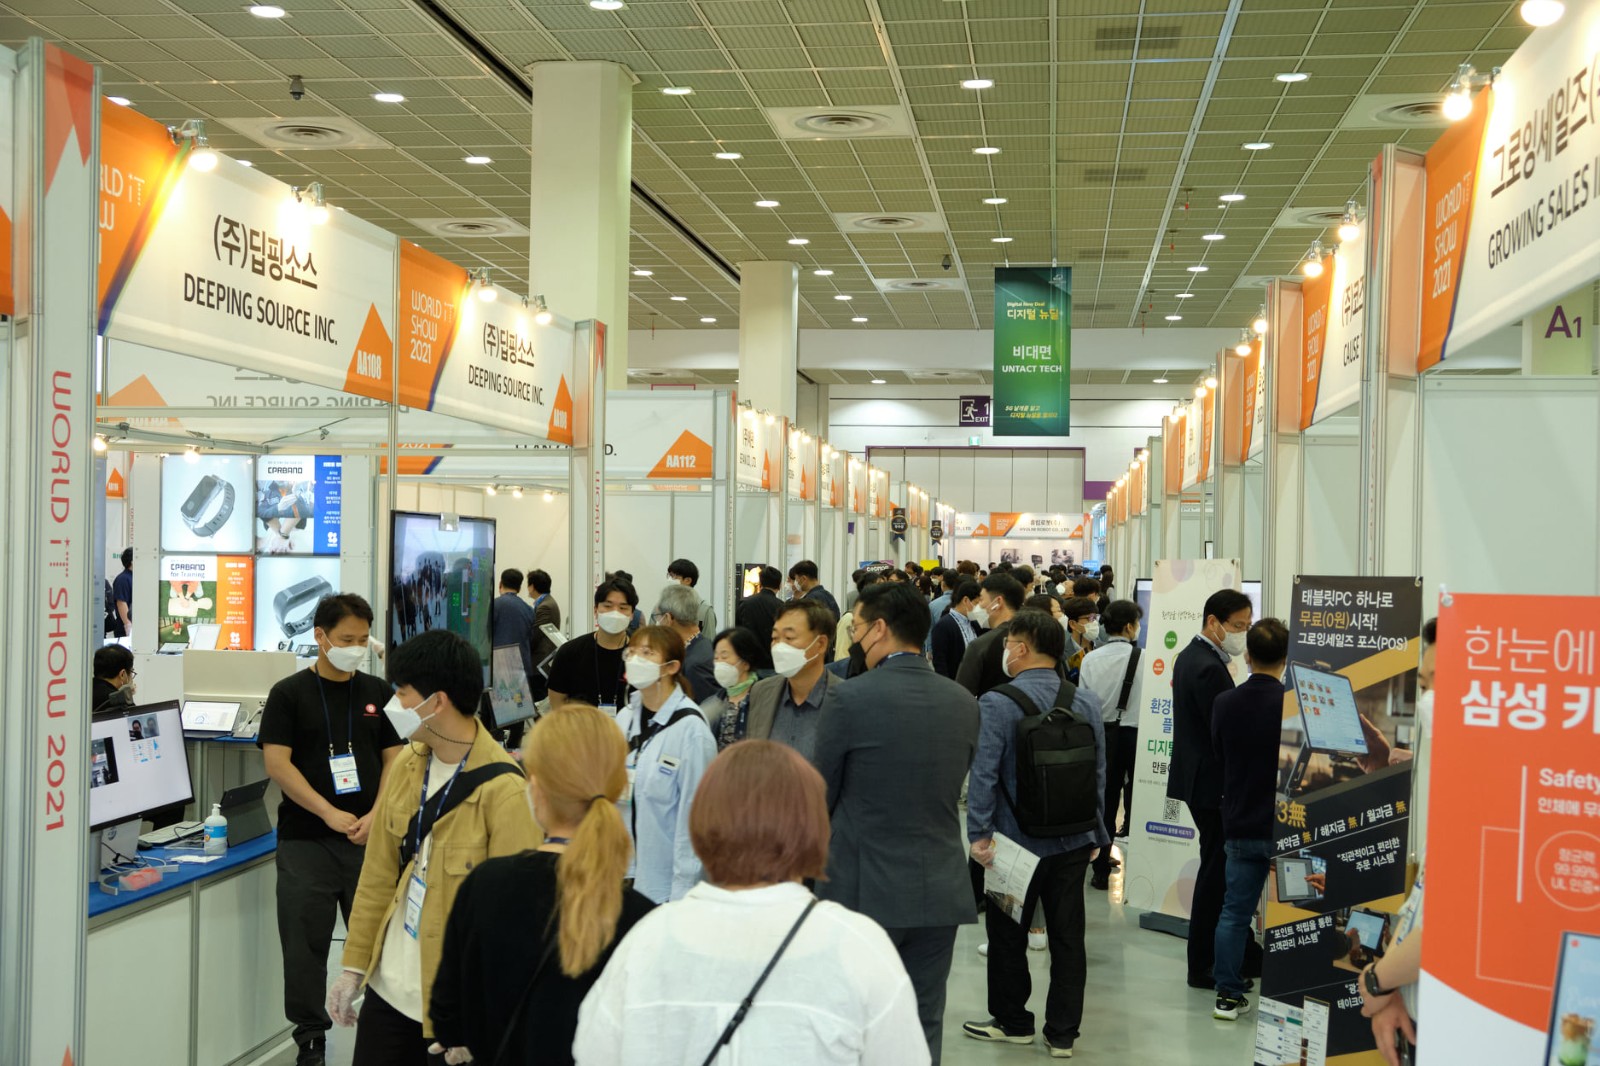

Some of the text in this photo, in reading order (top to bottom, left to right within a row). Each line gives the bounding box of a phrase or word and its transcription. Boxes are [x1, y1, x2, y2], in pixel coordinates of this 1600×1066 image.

[1490, 50, 1600, 198] 그로잉세일즈(
[1435, 181, 1462, 230] WORLD
[1488, 210, 1544, 269] GROWING
[1547, 163, 1589, 231] SALES
[213, 214, 318, 290] (주)딥핑소스
[1434, 219, 1458, 265] SHOW
[1432, 257, 1451, 299] 2021
[183, 272, 338, 346] DEEPING SOURCE INC.
[411, 289, 442, 319] WORLD
[1007, 308, 1059, 320] 디지털 뉴딜
[410, 314, 438, 342] SHOW
[1544, 304, 1582, 339] A1
[410, 338, 432, 365] 2021
[483, 321, 535, 368] (주)딥핑소스
[1012, 345, 1052, 360] 비대면
[1343, 334, 1360, 367] CAUSE
[357, 349, 382, 381] AA108
[1002, 365, 1062, 373] UNTACT TECH
[468, 364, 545, 407] DEEPING SOURCE INC.
[984, 402, 989, 416] 1
[50, 370, 72, 524] WORLD
[666, 454, 696, 468] AA112
[181, 571, 205, 579] Training
[1301, 590, 1394, 609] 태블릿PC 하나로
[47, 587, 69, 719] SHOW
[1297, 632, 1408, 652] 그로잉세일즈 포스(POS)
[1465, 624, 1595, 675] 한눈에
[1150, 697, 1173, 715] 환경
[1460, 679, 1547, 731] 삼성
[45, 734, 66, 832] 2021
[1539, 767, 1600, 796] Safety
[1277, 800, 1307, 828] 3無
[1538, 796, 1600, 818] 인체에 무
[1276, 833, 1301, 852] 계약금
[1302, 830, 1312, 844] 無
[1320, 818, 1346, 838] 해지금
[1347, 815, 1358, 829] 無
[1366, 803, 1394, 823] 월과금
[1395, 800, 1407, 815] 無
[1377, 836, 1401, 853] 편리한
[1355, 859, 1372, 872] 주문
[1553, 862, 1600, 879] 99.99%
[1550, 876, 1567, 891] UL
[1295, 921, 1317, 935] 적립을
[1318, 916, 1333, 930] 통한
[1269, 938, 1296, 954] 고객관리
